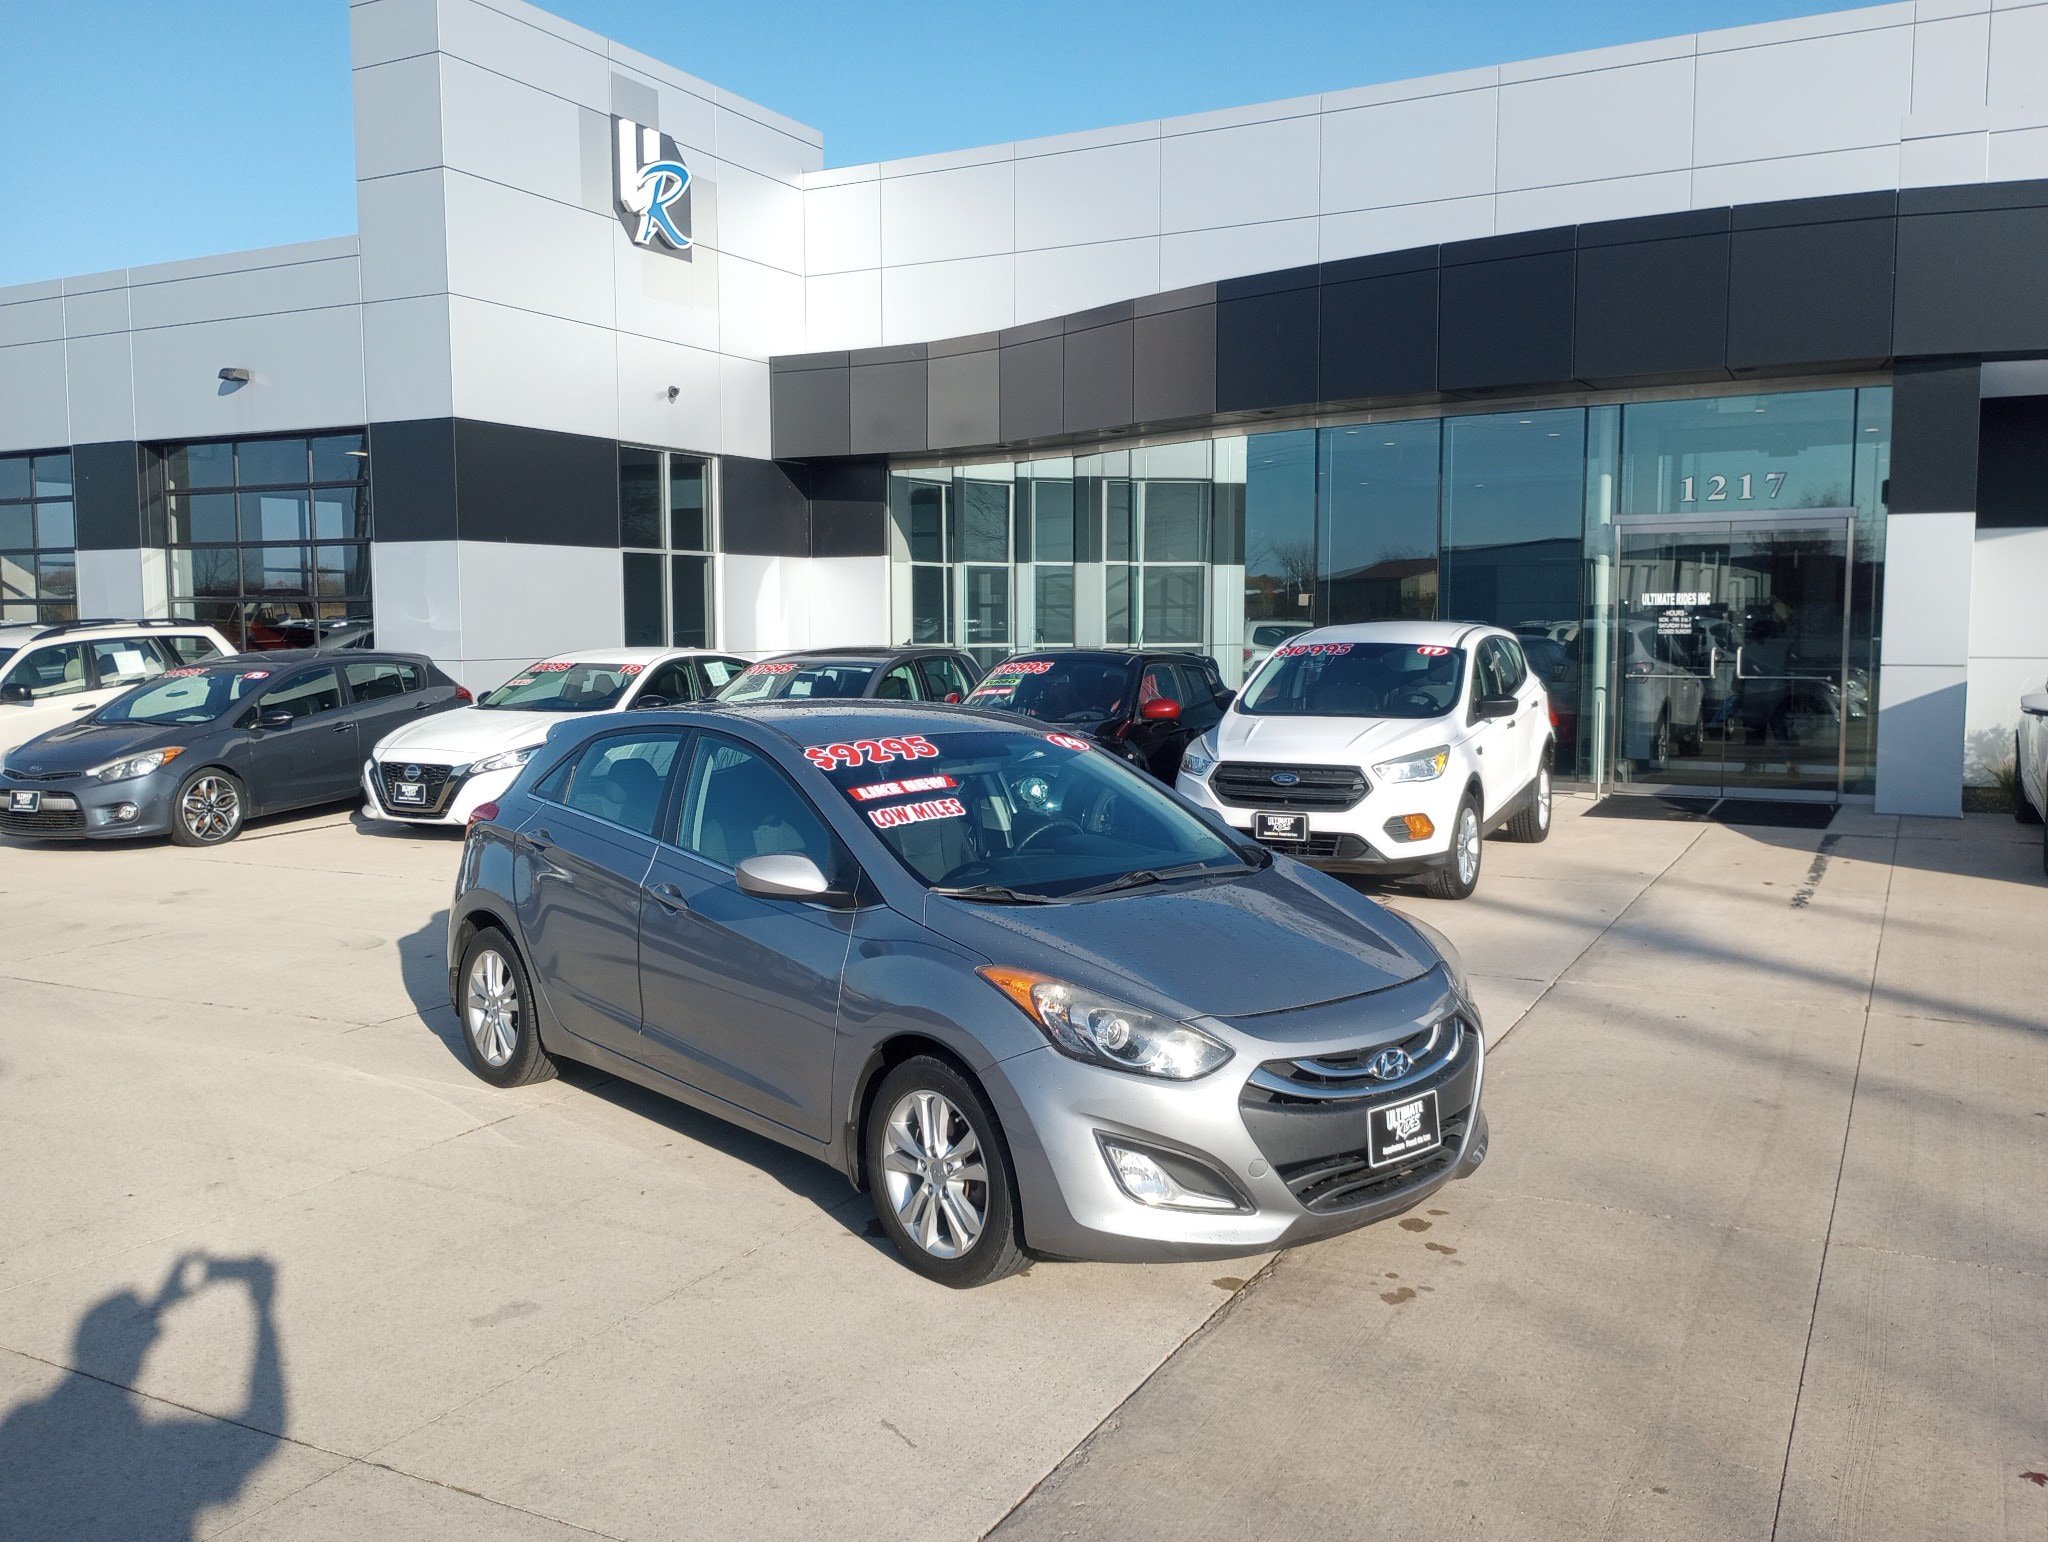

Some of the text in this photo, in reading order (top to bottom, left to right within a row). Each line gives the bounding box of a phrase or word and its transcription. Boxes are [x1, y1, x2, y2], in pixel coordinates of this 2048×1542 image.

[1680, 472, 1787, 502] 1217
[1641, 592, 1711, 606] ULTIMATE RIDES INC
[804, 736, 939, 771] $9295
[856, 776, 948, 799] LIKE NEW
[869, 799, 965, 828] LOW MILES
[1386, 1100, 1425, 1131] ULTIMATE
